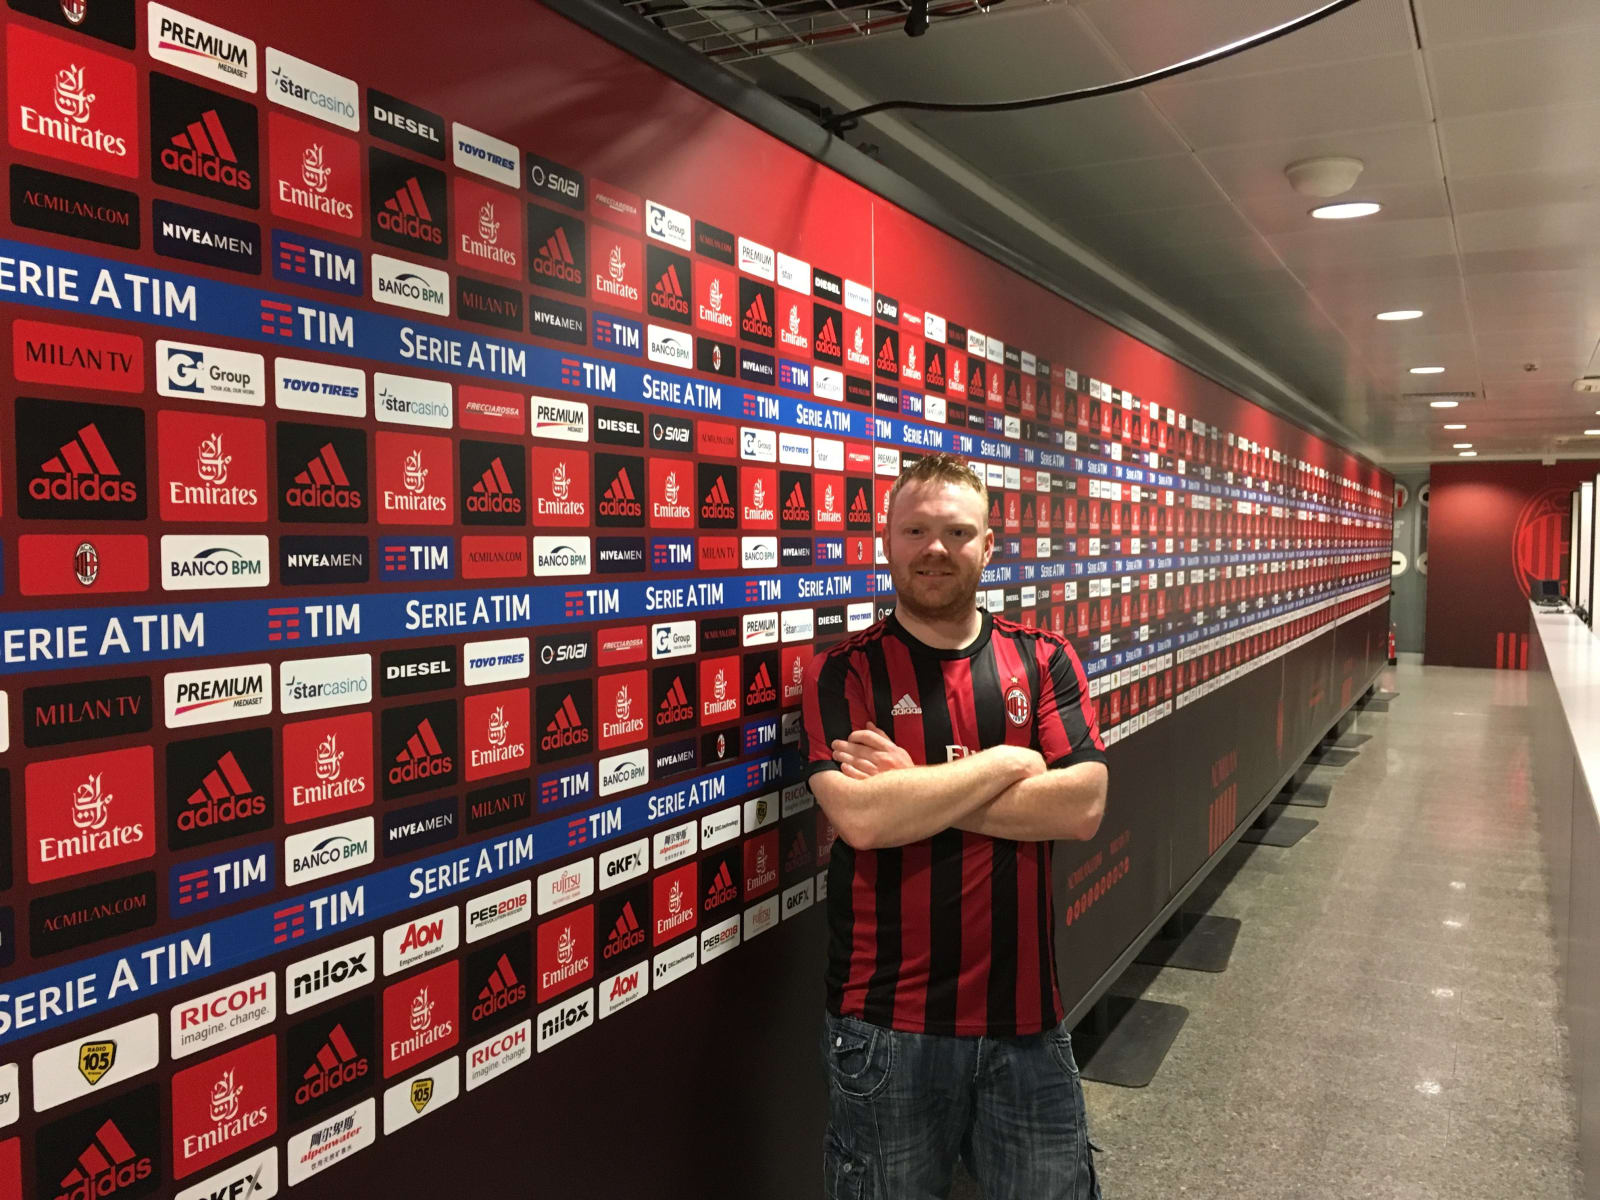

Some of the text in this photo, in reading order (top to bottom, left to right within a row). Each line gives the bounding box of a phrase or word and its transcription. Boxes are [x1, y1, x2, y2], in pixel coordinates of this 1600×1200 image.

[160, 17, 249, 68] PREMIUM
[217, 62, 249, 79] MEDIASET
[20, 105, 127, 157] Emirates
[373, 105, 440, 143] DIESEL
[160, 145, 252, 191] adidas
[458, 140, 515, 171] TOYO TIRES
[23, 189, 130, 227] ACMILAN.COM
[278, 179, 354, 220] Emirates
[376, 210, 442, 245] adidas
[668, 220, 686, 236] Group
[461, 233, 517, 266] Emirates
[309, 248, 357, 285] TIM
[533, 258, 582, 284] adidas
[89, 269, 122, 308] A
[124, 273, 197, 321] TIM
[378, 277, 444, 305] BANCO BPM
[596, 274, 639, 301] Emirates
[297, 305, 355, 349] TIM
[700, 304, 732, 328] Emirates
[612, 323, 640, 349] TIM
[780, 330, 808, 348] Emirates
[816, 340, 840, 358] adidas
[25, 341, 134, 373] MILAN TV
[399, 327, 527, 377] SERIE A TIM
[209, 365, 251, 388] Group
[282, 378, 359, 399] TOYO TIRES
[583, 362, 616, 393] TIM
[642, 374, 720, 410] SERIE A TIM
[465, 401, 520, 417] FRECCIAROSSA
[536, 405, 584, 425] PREMIUM
[758, 396, 780, 420] TIM
[597, 417, 640, 434] DIESEL
[876, 418, 892, 440] TIM
[1024, 448, 1034, 464] TIM
[28, 472, 137, 502] adidas
[169, 482, 258, 506] Emirates
[286, 484, 361, 508] adidas
[384, 491, 447, 511] Emirates
[466, 492, 522, 513] adidas
[816, 508, 842, 522] Emirates
[848, 508, 870, 522] adidas
[410, 545, 448, 570] TIM
[538, 553, 587, 567] BANCO BPM
[826, 542, 842, 558] TIM
[171, 559, 261, 577] BANCO BPM
[586, 588, 620, 615] TIM
[646, 582, 724, 610] SERIE A TIM
[758, 580, 782, 602] TIM
[304, 604, 361, 638] TIM
[405, 593, 531, 630] SERIE A TIM
[0, 612, 205, 663] ERIE A TIM
[674, 632, 690, 646] Group
[386, 660, 451, 680] DIESEL
[469, 653, 525, 669] TOYO TIRES
[176, 675, 263, 703] PREMIUM
[232, 696, 263, 708] MEDIASET
[746, 688, 776, 706] adidas
[35, 695, 142, 728] MILAN TV
[656, 706, 694, 726] adidas
[704, 698, 738, 716] Emirates
[891, 706, 923, 717] adidas
[541, 726, 589, 751] adidas
[603, 715, 644, 738] Emirates
[758, 724, 776, 744] TIM
[471, 741, 525, 768] Emirates
[388, 755, 453, 785] adidas
[292, 774, 365, 807] Emirates
[560, 772, 590, 798] TIM
[176, 793, 267, 833] adidas
[471, 791, 527, 820] MILAN TV
[589, 806, 622, 839] TIM
[39, 822, 144, 863] Emirates
[293, 840, 368, 873] BANCO BPM
[213, 855, 267, 894] TIM
[408, 833, 534, 898] SERIE A TIM
[606, 849, 642, 877] GKFX
[552, 872, 581, 895] FUJITSU
[43, 893, 147, 933] ACMILAN.COM
[309, 884, 365, 931] TIM
[704, 886, 738, 912] adidas
[786, 888, 810, 910] GKFX
[603, 929, 646, 959] adidas
[108, 957, 138, 999] A
[141, 932, 212, 985] TIM
[399, 951, 423, 968] Empower
[542, 955, 590, 989] Emirates
[293, 952, 367, 999] nilox
[180, 982, 267, 1031] RICOH
[471, 983, 527, 1022] adidas
[180, 1006, 270, 1047] imagine. change.
[541, 1000, 590, 1040] nilox
[390, 1020, 453, 1061] Emirates
[471, 1027, 527, 1068] RICOH
[83, 1053, 110, 1071] 105
[471, 1045, 527, 1081] imagine. change.
[294, 1057, 369, 1105] adidas
[413, 1086, 430, 1103] 105
[183, 1105, 268, 1159] Emirates
[299, 1126, 362, 1164] alpenwater
